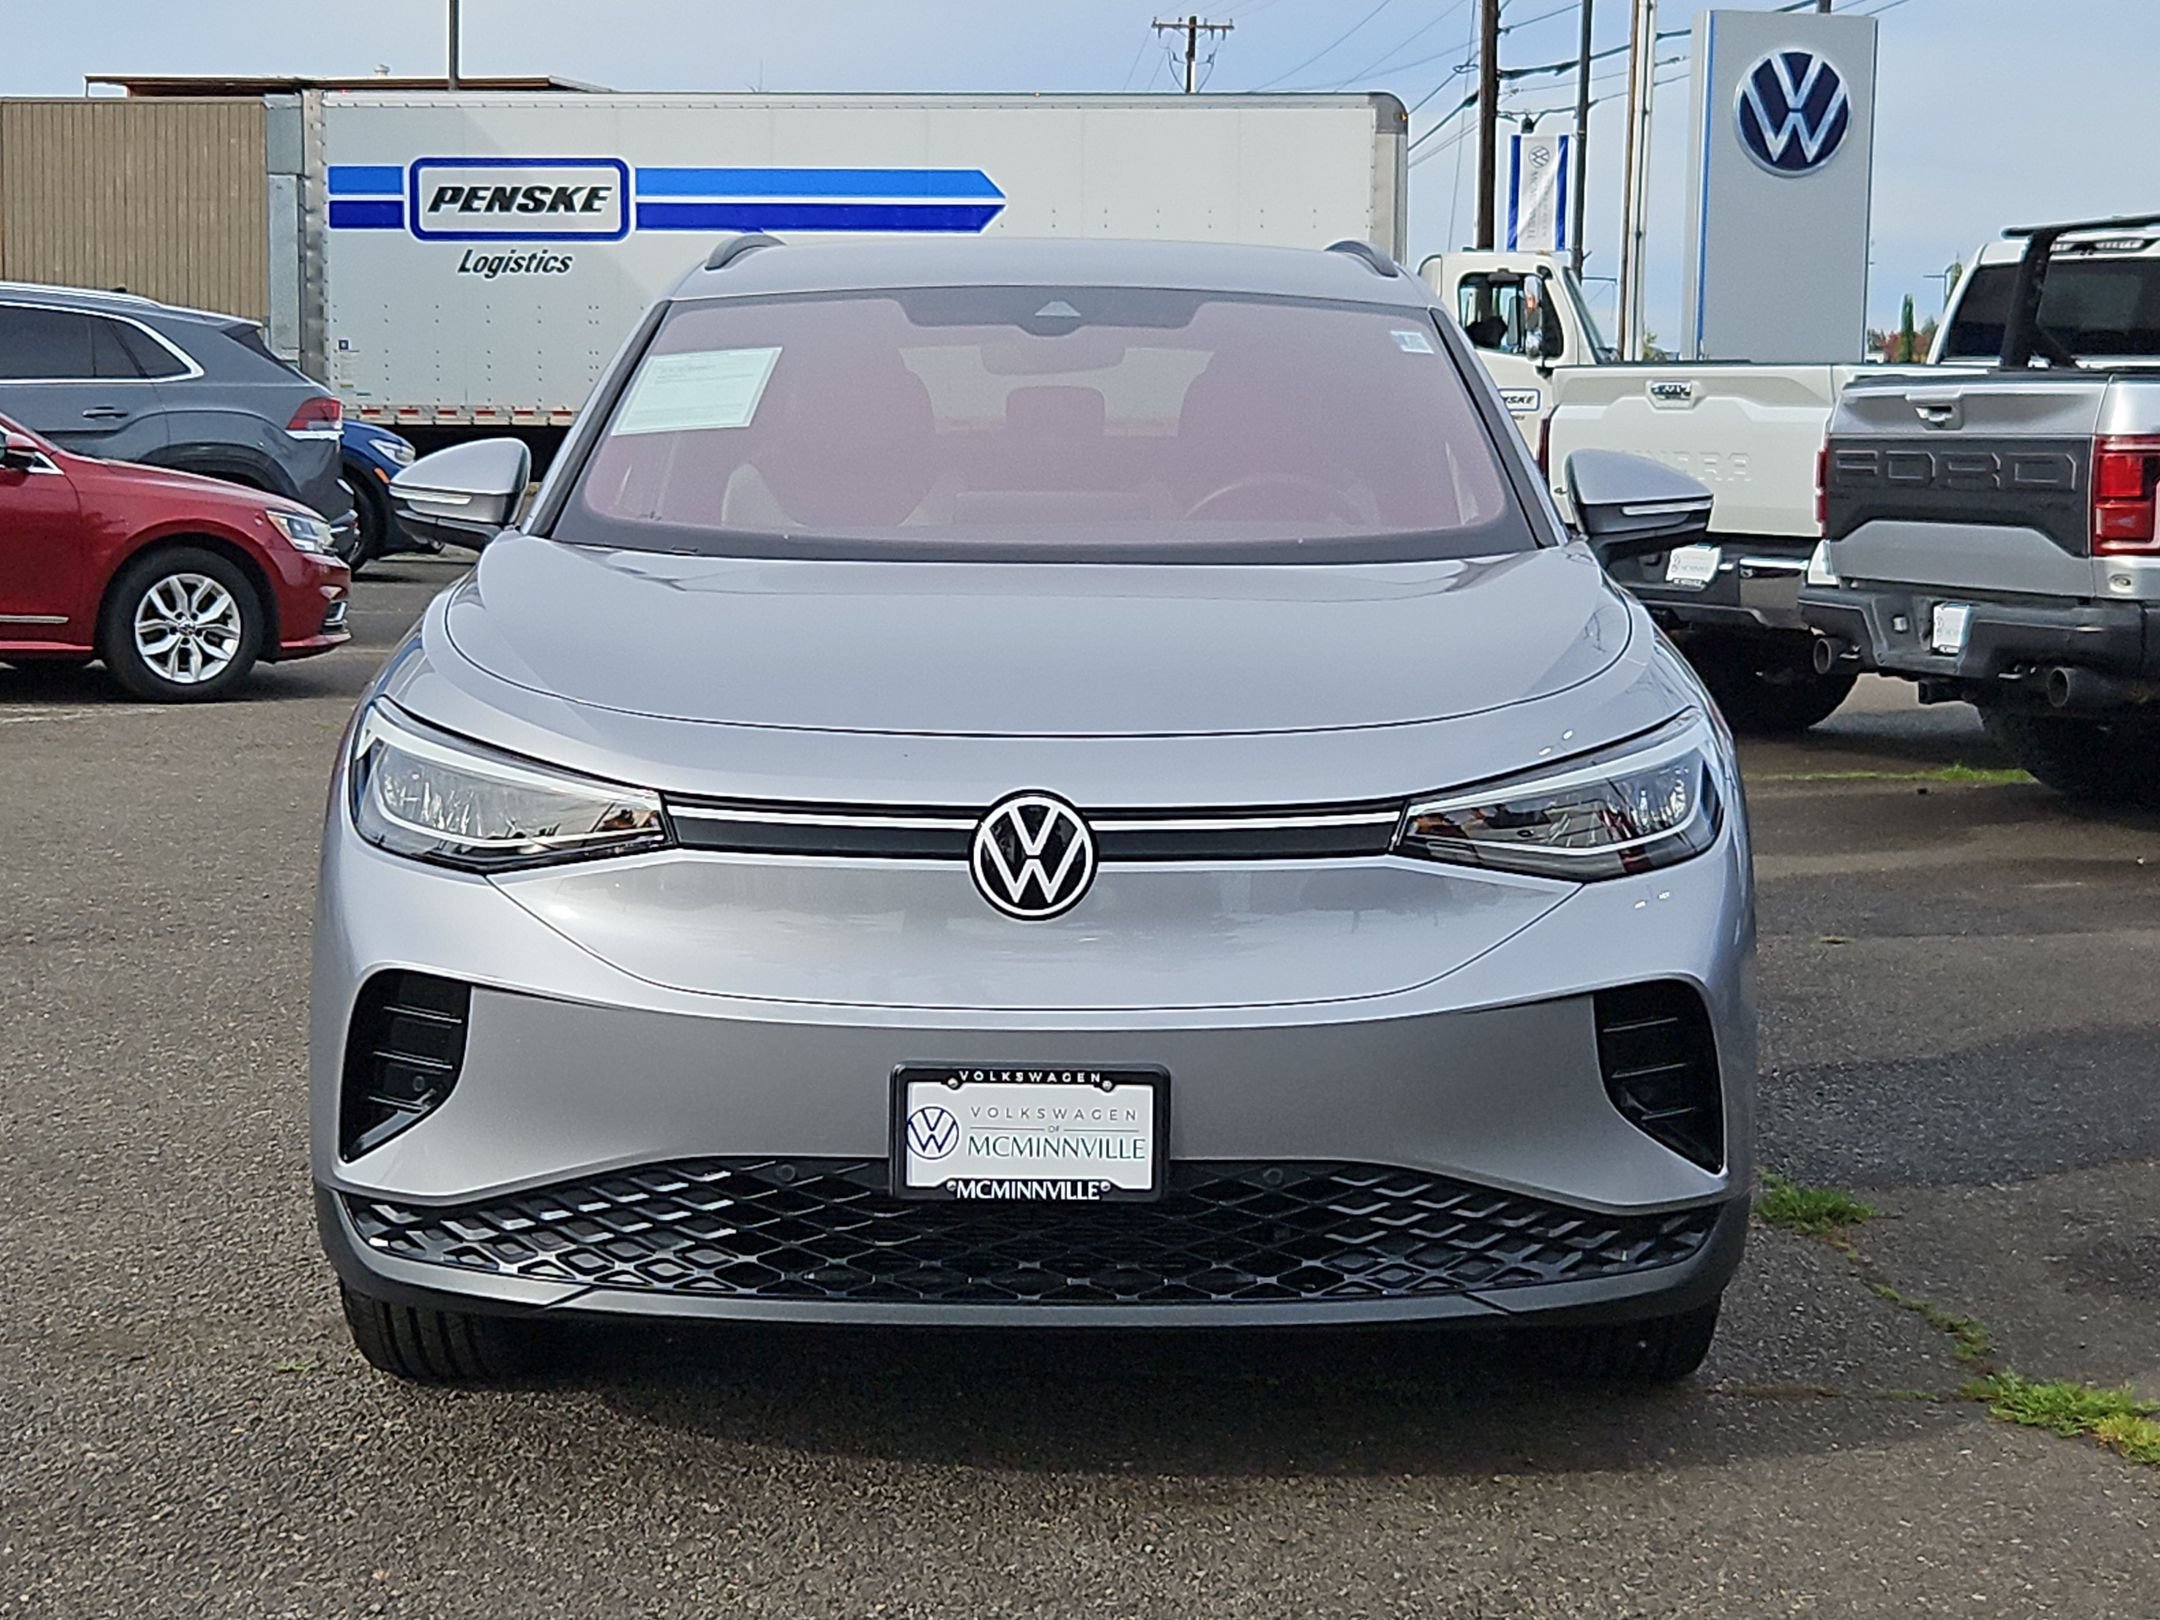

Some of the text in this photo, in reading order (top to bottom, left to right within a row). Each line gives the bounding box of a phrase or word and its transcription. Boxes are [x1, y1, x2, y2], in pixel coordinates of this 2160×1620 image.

[427, 186, 612, 213] PENSKE
[457, 249, 573, 279] Logistics
[1834, 449, 2077, 491] FORD
[959, 1071, 1100, 1083] VOLKSWAGEN
[970, 1106, 1137, 1121] VOLKSWAGEN
[968, 1136, 1146, 1159] MCMINNVILLE
[956, 1180, 1100, 1200] MCMINNVILLE
